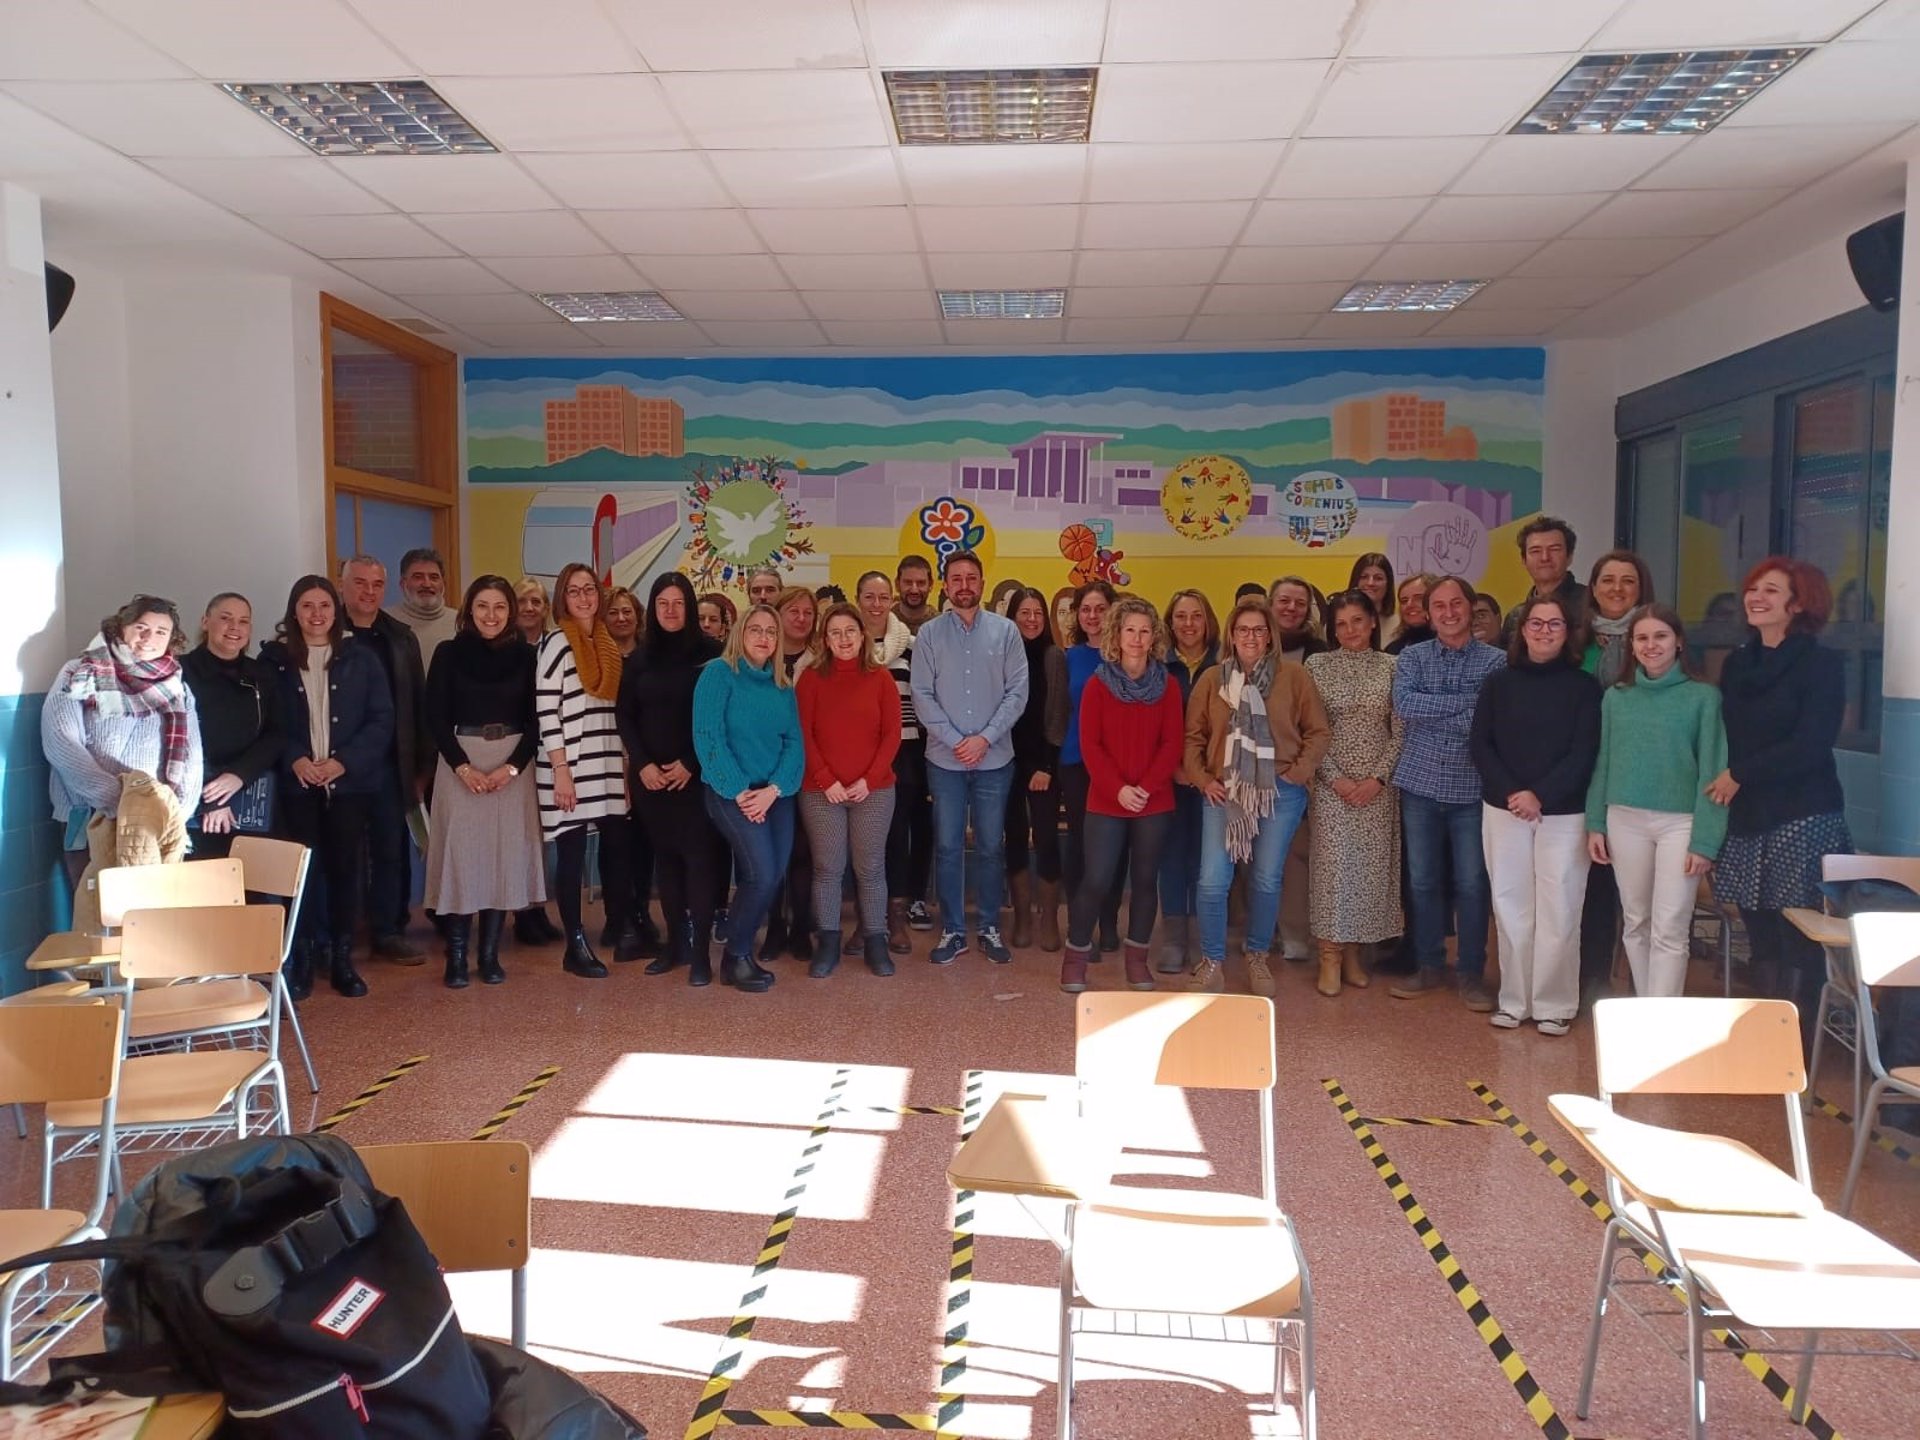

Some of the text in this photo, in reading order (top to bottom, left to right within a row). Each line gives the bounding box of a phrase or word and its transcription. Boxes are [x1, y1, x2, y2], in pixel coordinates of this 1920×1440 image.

[1294, 478, 1344, 493] SOMOS
[1286, 493, 1354, 510] COMENIUS
[327, 1287, 371, 1329] HUNTER
